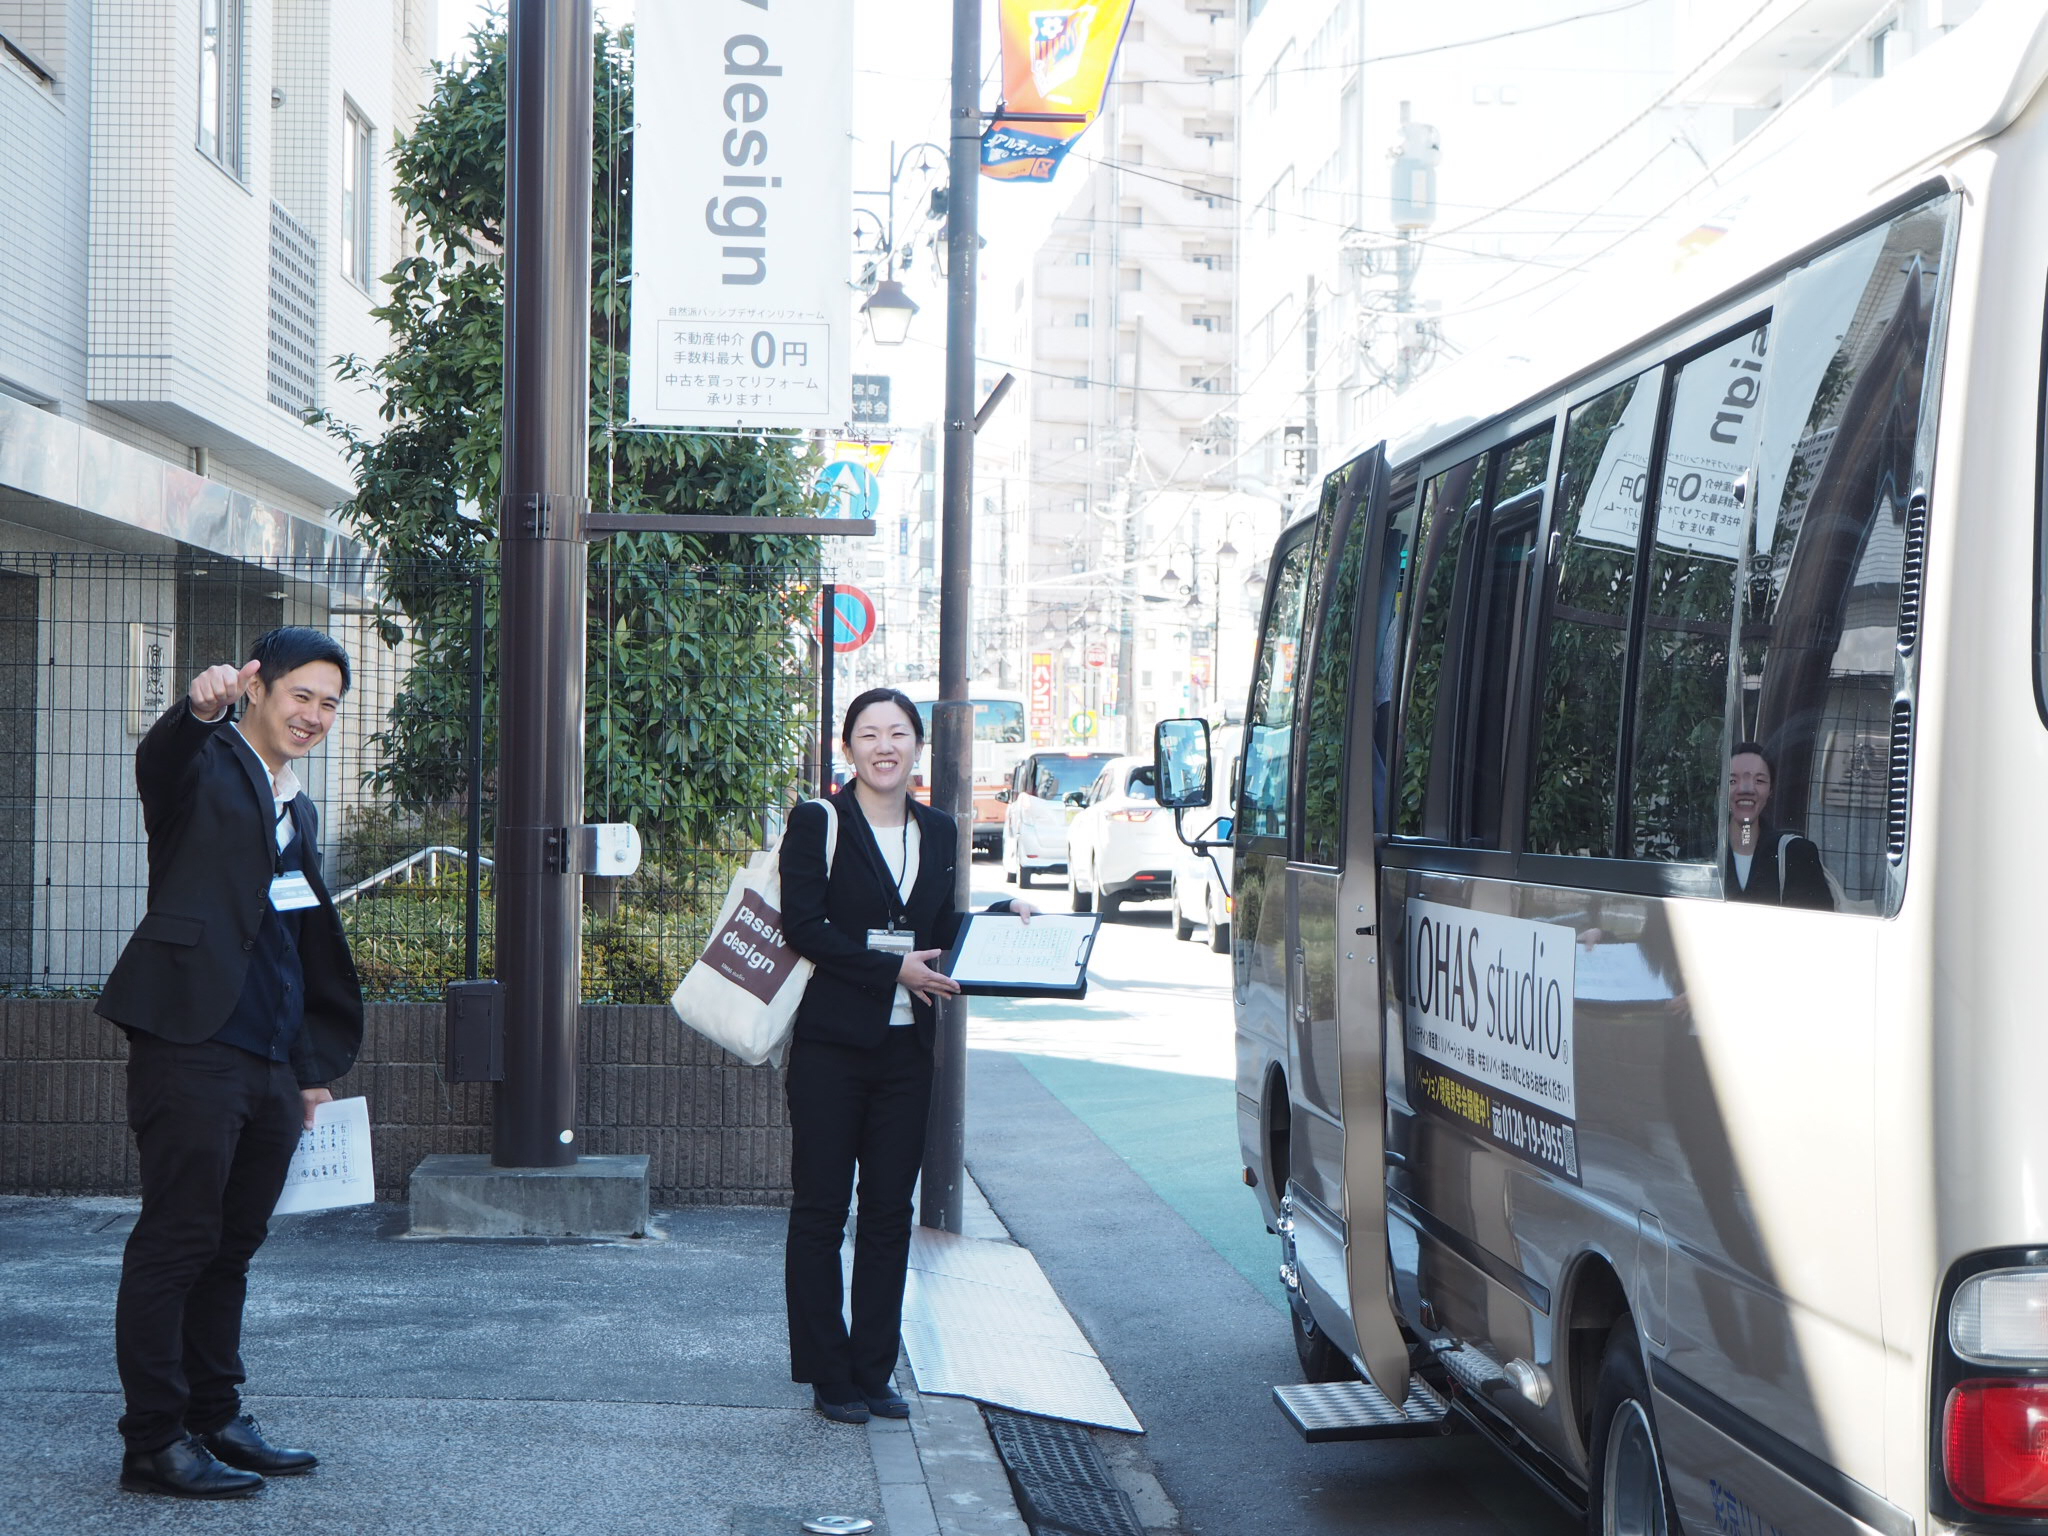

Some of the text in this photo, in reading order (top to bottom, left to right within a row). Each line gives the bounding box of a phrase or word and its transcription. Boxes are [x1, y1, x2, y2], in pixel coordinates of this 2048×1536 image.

[705, 34, 783, 286] design
[673, 351, 744, 366] 手数料最大
[674, 331, 744, 347] 不動産仲介
[665, 373, 818, 390] 中古を買ってリフォーム
[1033, 666, 1050, 711] ハンコ
[735, 905, 786, 948] passiv
[722, 930, 775, 974] design
[1408, 915, 1562, 1060] LOHAS studio
[1502, 1104, 1565, 1167] 0120-19-5955
